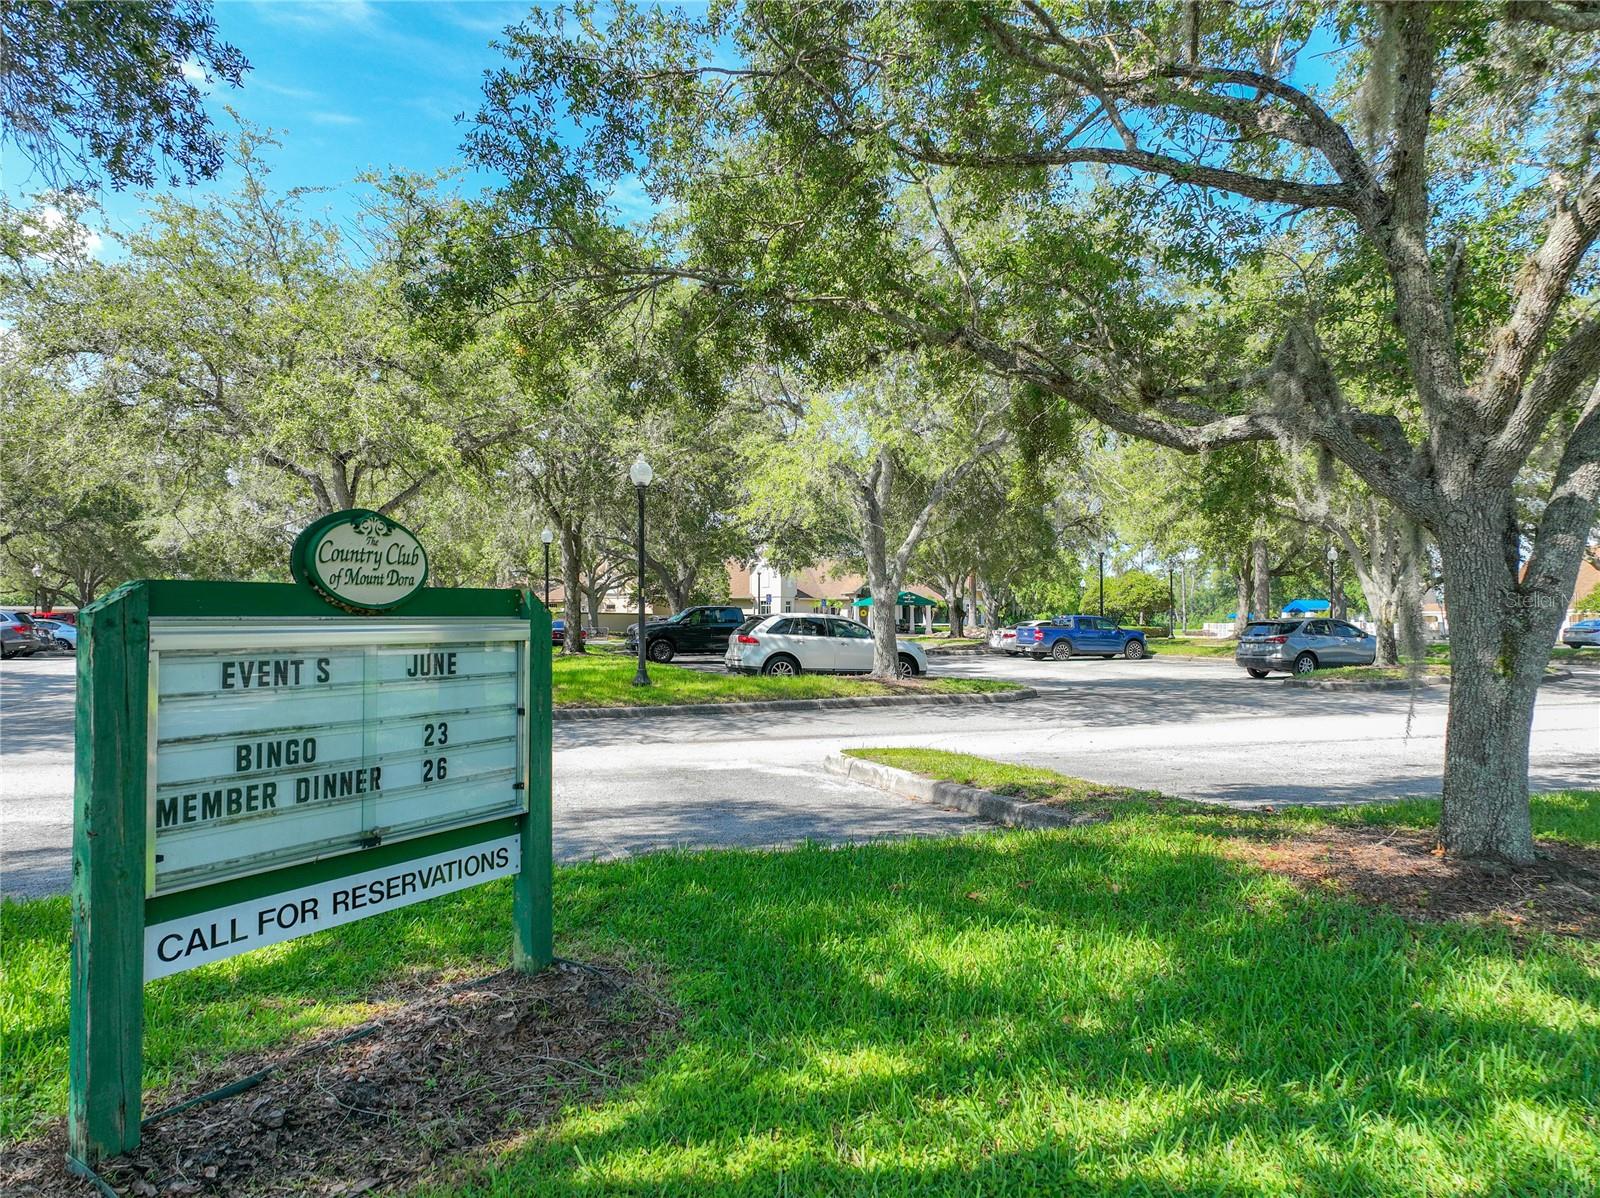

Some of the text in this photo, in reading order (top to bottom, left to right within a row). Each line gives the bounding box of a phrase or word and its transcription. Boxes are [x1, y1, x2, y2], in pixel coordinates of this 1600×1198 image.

[318, 540, 420, 571] Country Club
[366, 535, 380, 547] The
[329, 567, 415, 590] of Mount Dora
[407, 652, 457, 678] JUNE
[235, 721, 449, 772] BINGO 23
[155, 756, 448, 829] MEMBER DINNER 26
[156, 846, 510, 963] CALL FOR RESERVATIONS
